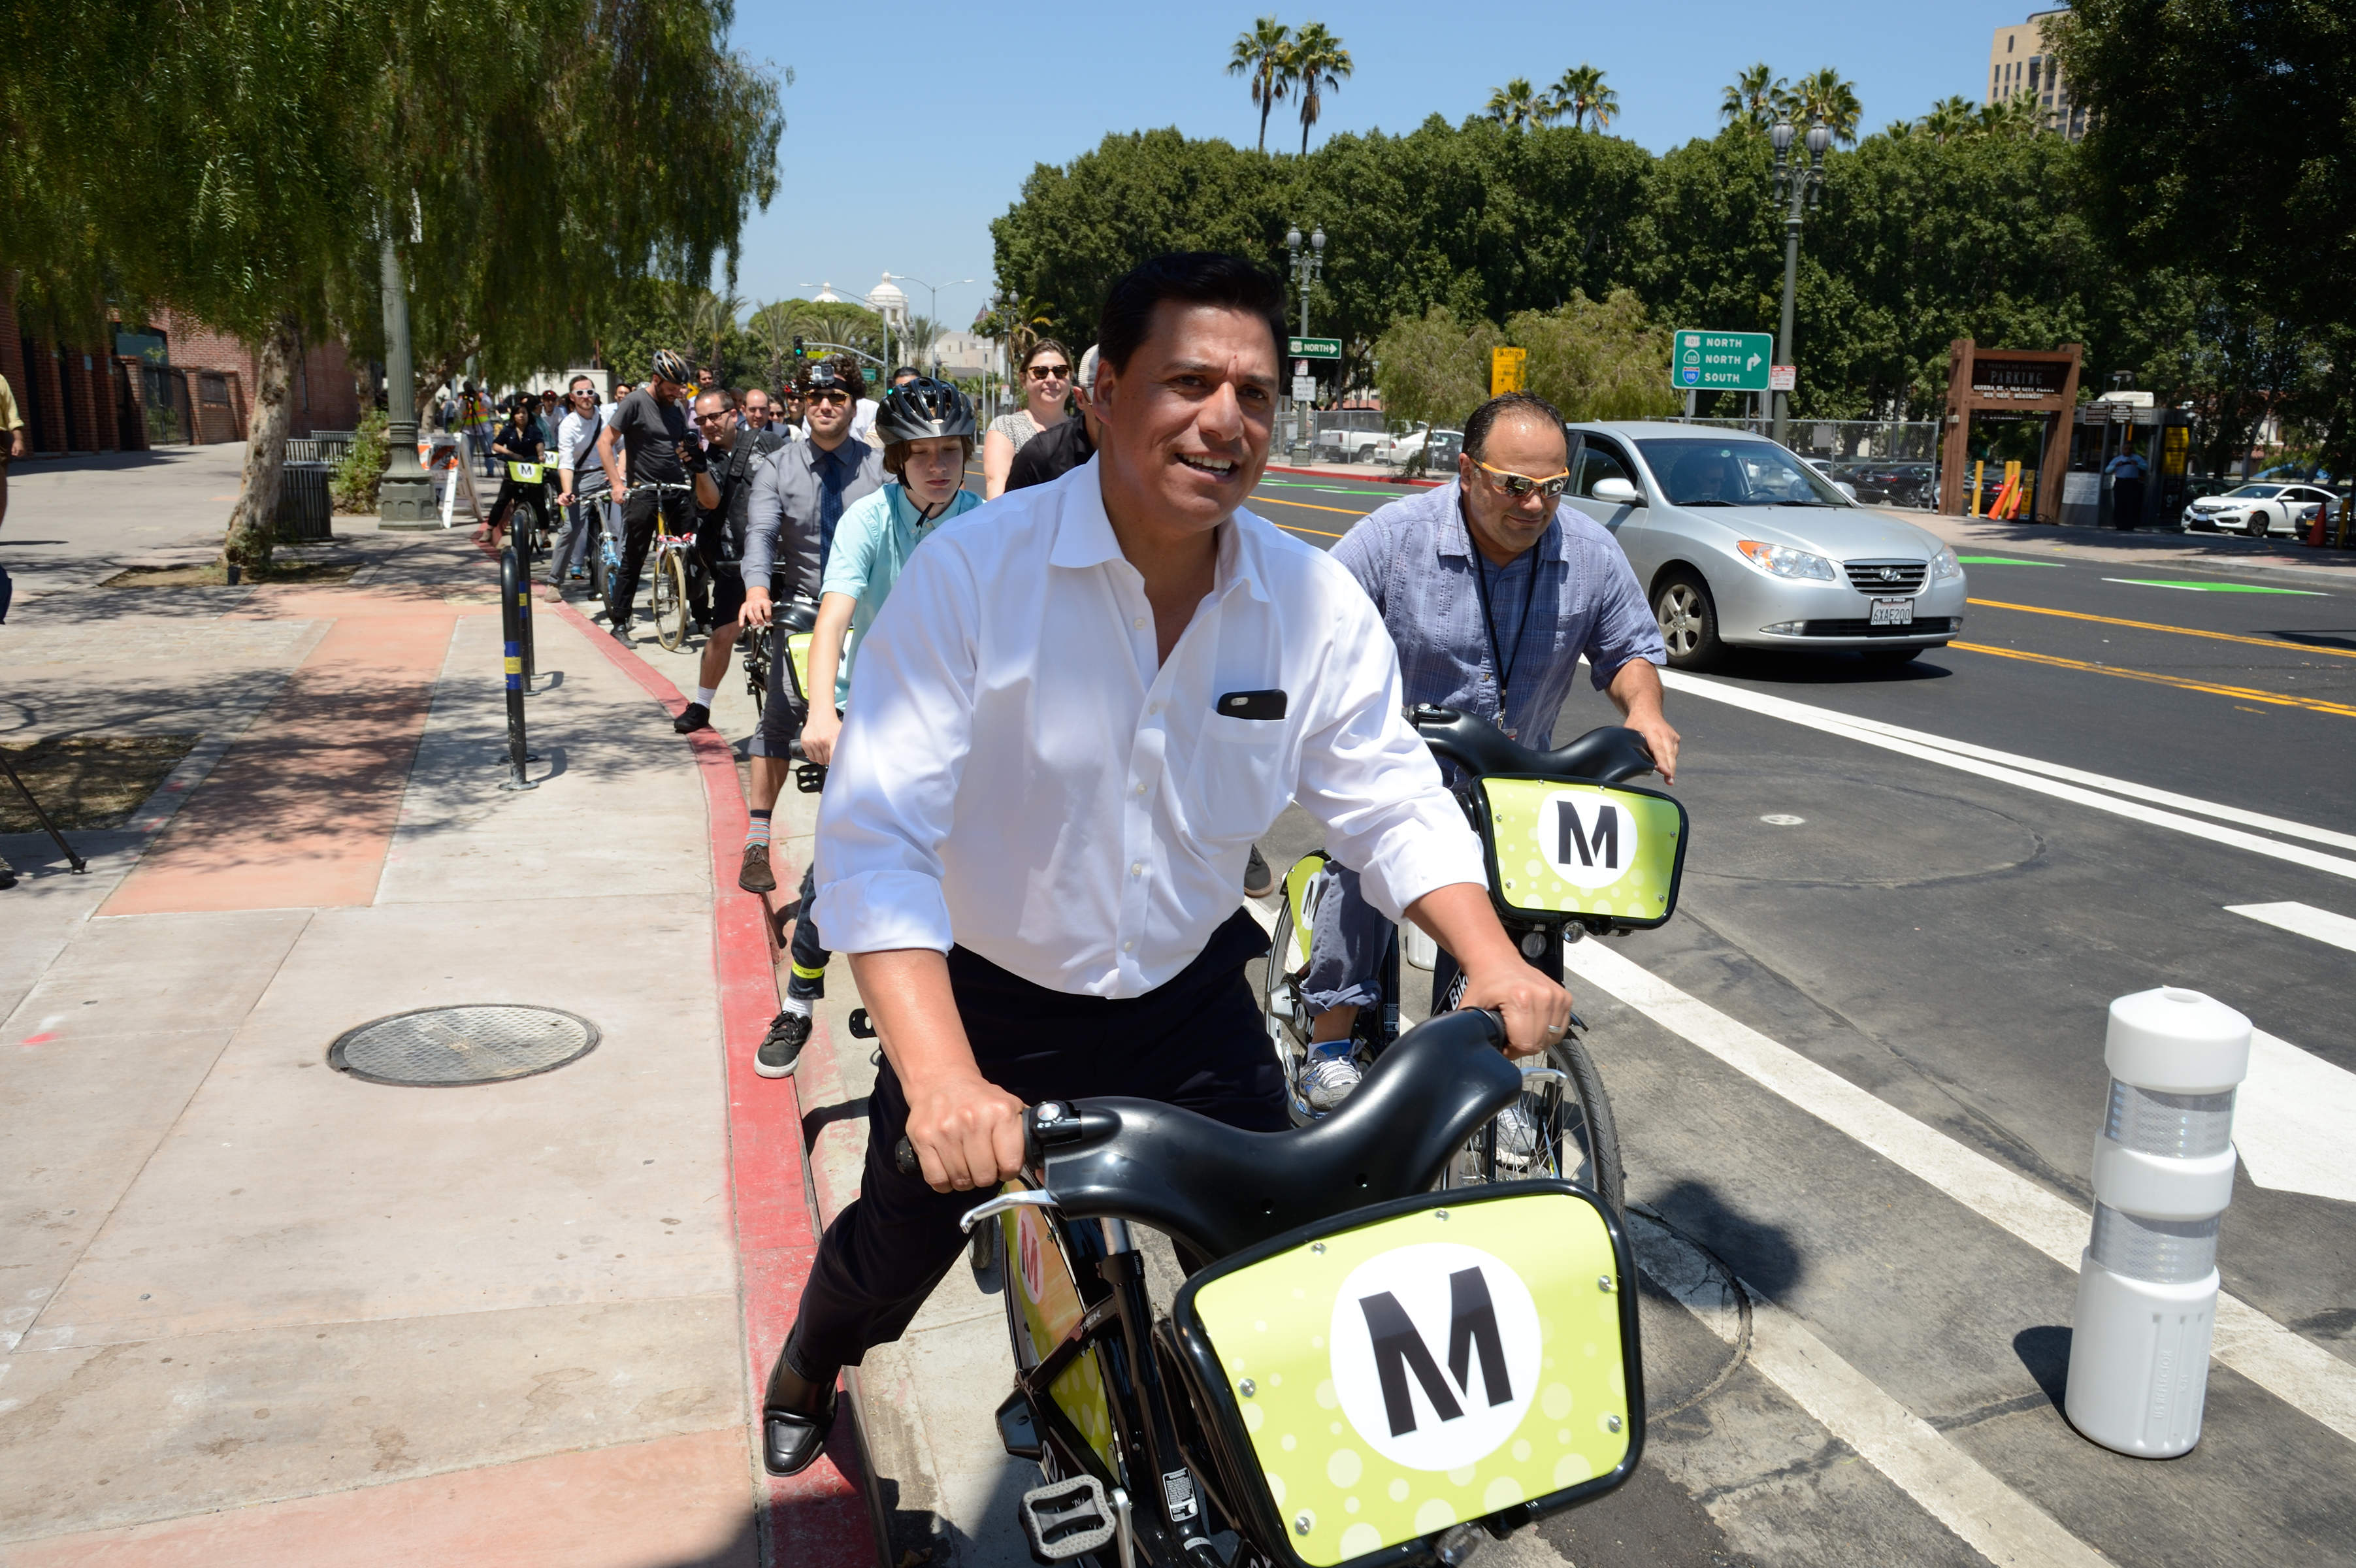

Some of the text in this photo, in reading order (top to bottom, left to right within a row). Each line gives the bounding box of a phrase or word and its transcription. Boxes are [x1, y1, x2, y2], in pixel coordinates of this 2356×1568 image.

[1303, 344, 1330, 352] NORTH
[1706, 338, 1742, 348] NORTH
[1705, 355, 1741, 365] NORTH
[1705, 372, 1741, 383] SOUTH
[1991, 371, 2043, 384] PARKING
[521, 465, 532, 475] M
[1556, 800, 1618, 869] M
[1448, 973, 1469, 1011] Bik
[1021, 1219, 1039, 1295] M
[1079, 1309, 1102, 1333] TREK
[1358, 1266, 1514, 1437] M
